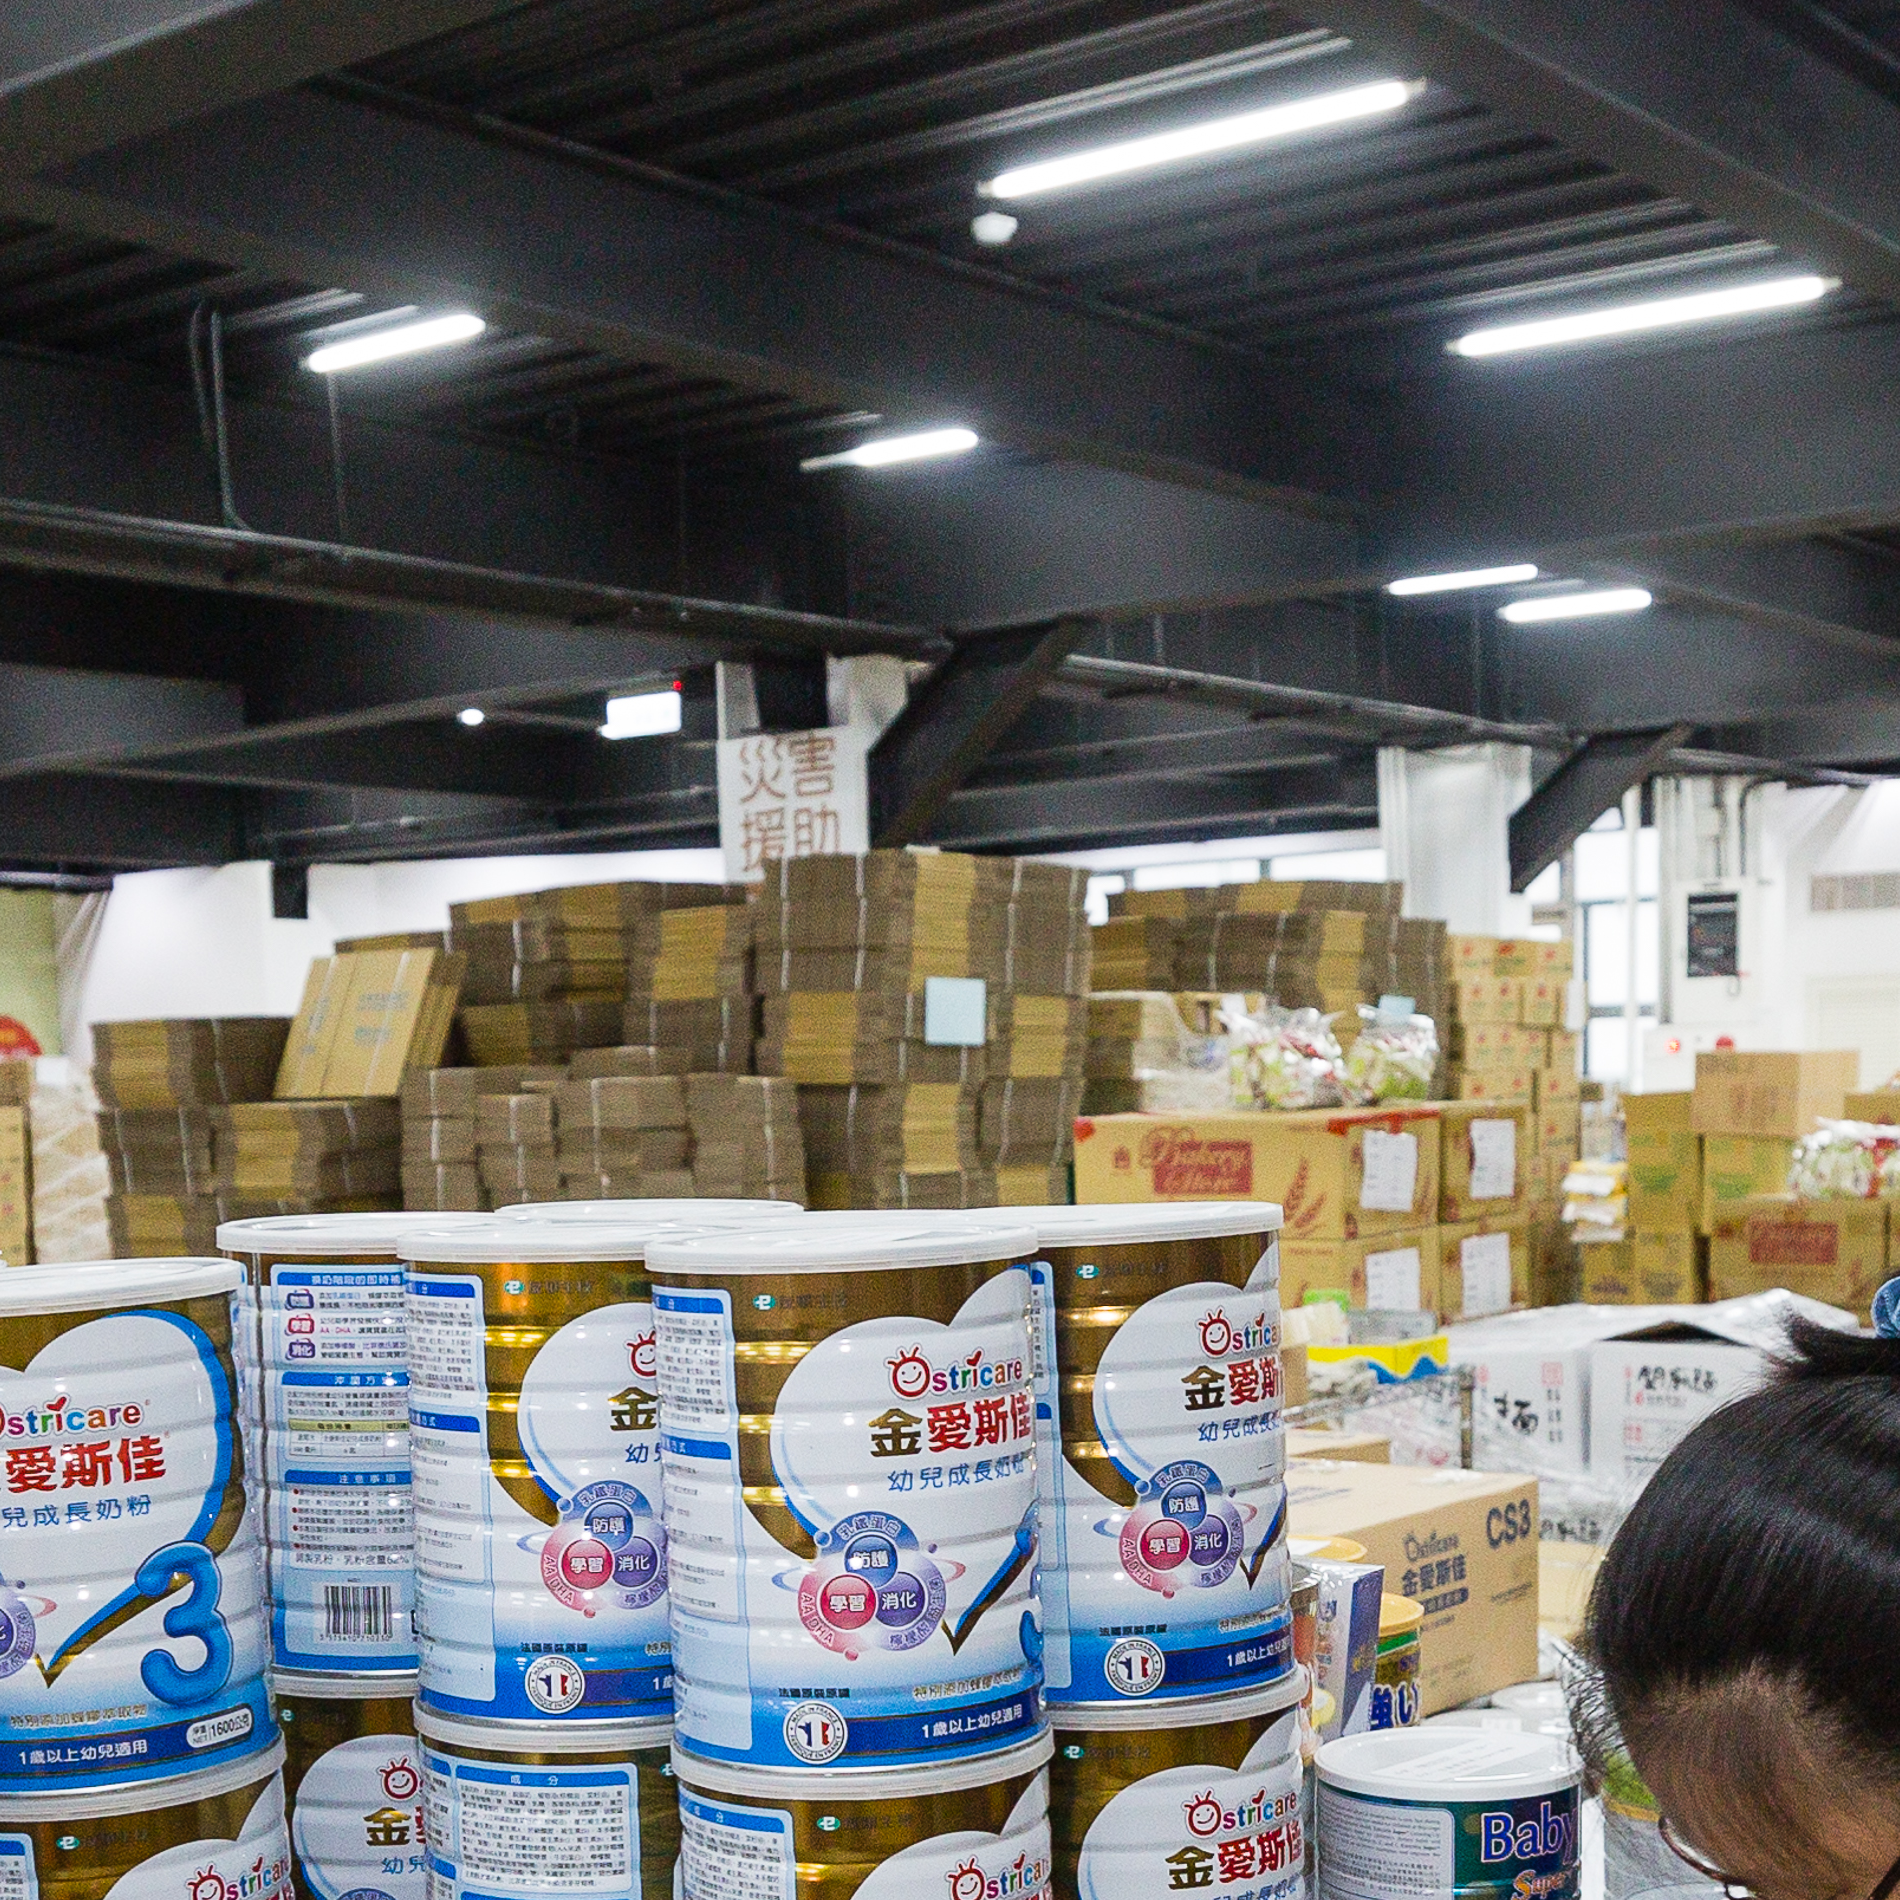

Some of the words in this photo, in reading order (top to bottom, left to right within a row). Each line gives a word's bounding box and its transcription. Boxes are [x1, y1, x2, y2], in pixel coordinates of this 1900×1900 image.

[739, 734, 839, 804] 災害
[885, 1344, 1023, 1399] Ostricare
[868, 1395, 1032, 1458] 金愛斯佳
[888, 1457, 1034, 1494] 幼兒成長奶粉
[1159, 1462, 1208, 1487] 乳鐵蛋白
[579, 1482, 636, 1507] 乳鐵蛋白
[840, 1513, 902, 1541] 乳鐵蛋白
[1194, 1533, 1222, 1550] 消化
[1486, 1500, 1532, 1550] CS3
[618, 1553, 650, 1573] 消化
[881, 1591, 917, 1610] 消化
[136, 1540, 234, 1705] 3
[922, 1704, 1023, 1740] 1歲以上幼兒適用
[18, 1740, 148, 1765] 1歲以上幼兒適用
[1481, 1801, 1578, 1865] Baby
[1165, 1825, 1302, 1891] 金愛斯佳
